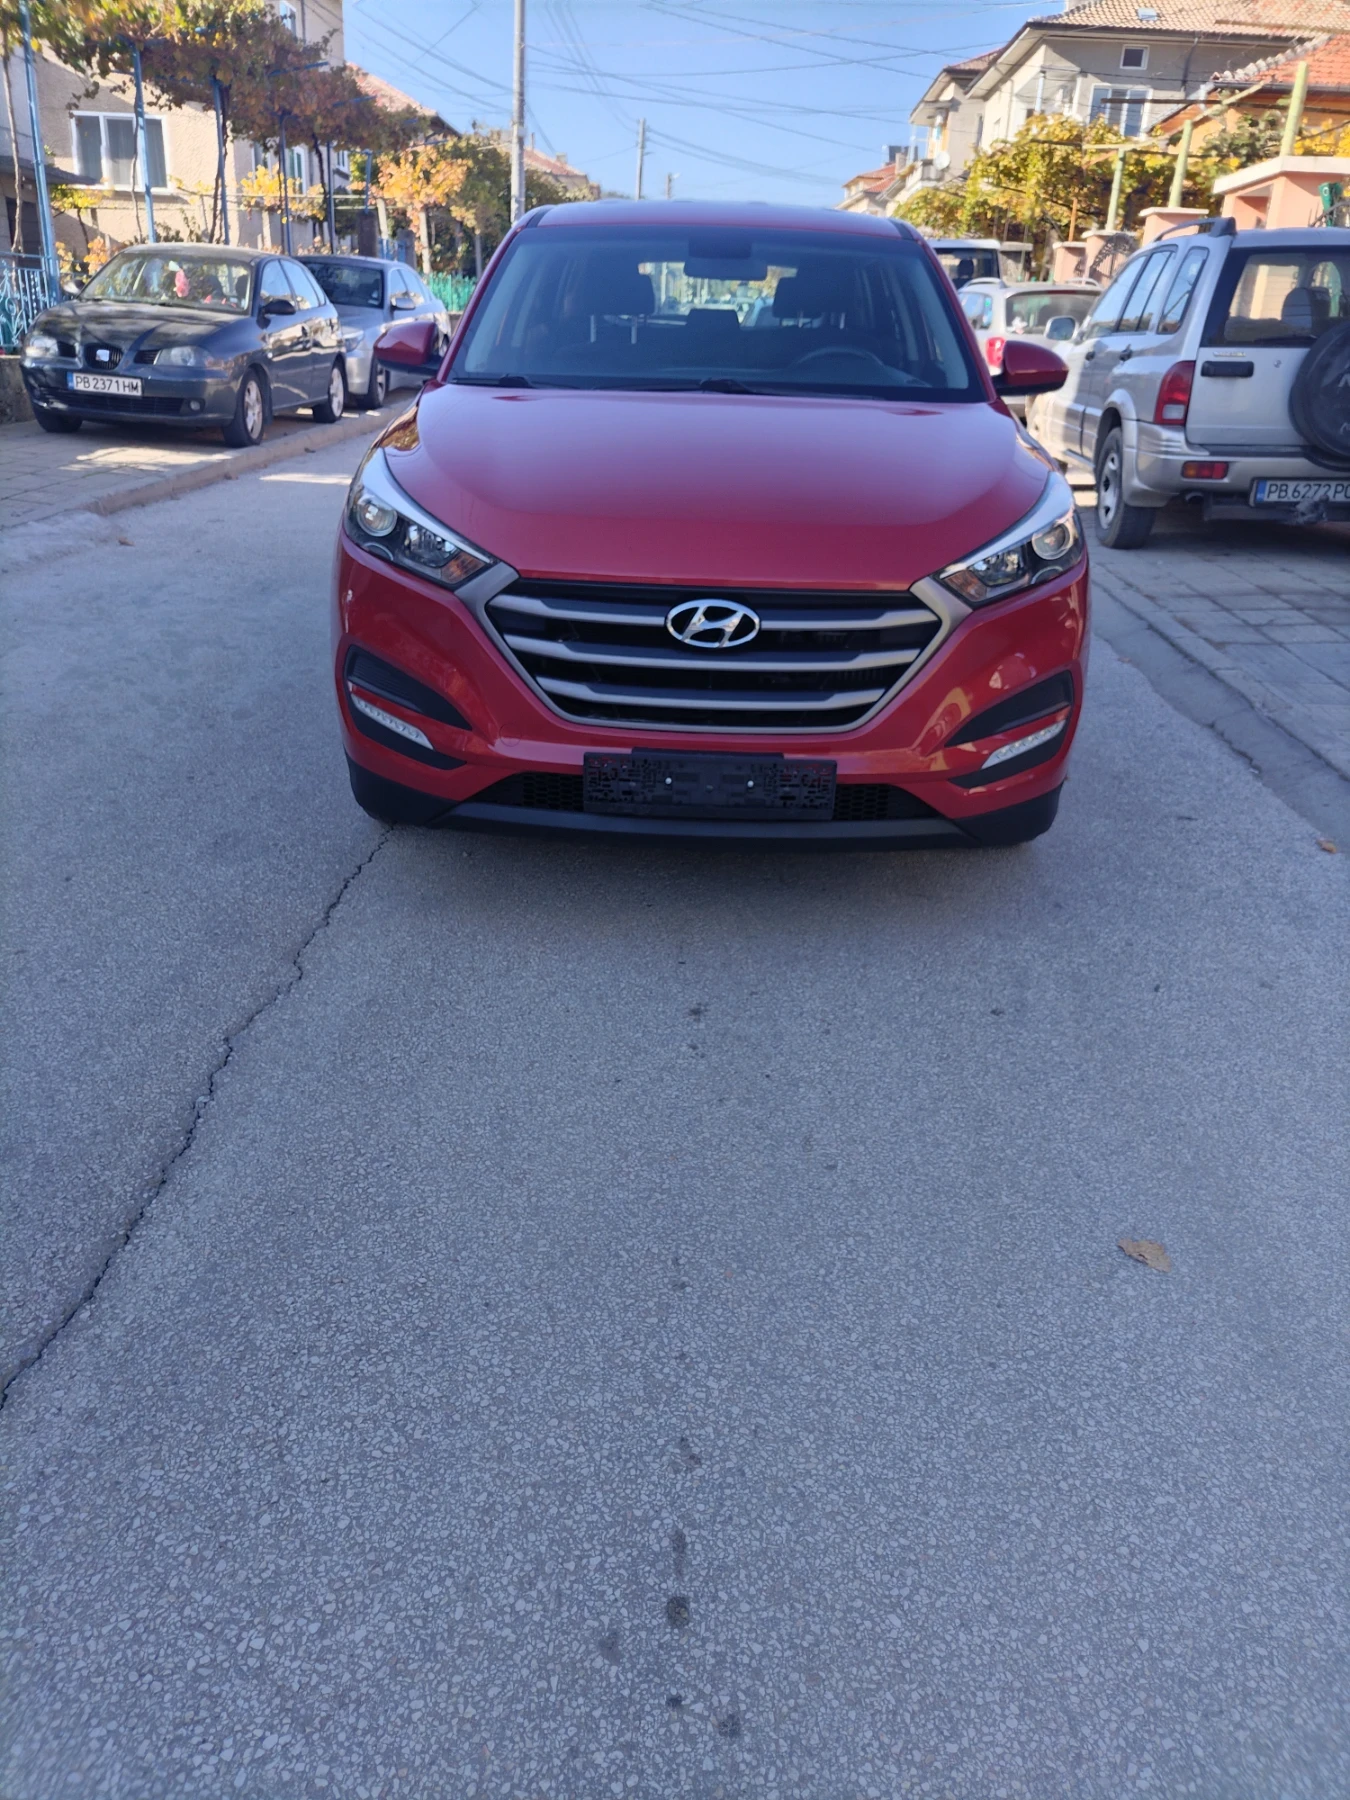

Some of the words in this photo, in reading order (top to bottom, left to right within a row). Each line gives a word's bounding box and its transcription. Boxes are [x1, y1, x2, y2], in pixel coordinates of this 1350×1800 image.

[75, 375, 91, 389] PB
[92, 377, 120, 392] 2371
[122, 380, 139, 394] HM
[1267, 483, 1289, 499] PB
